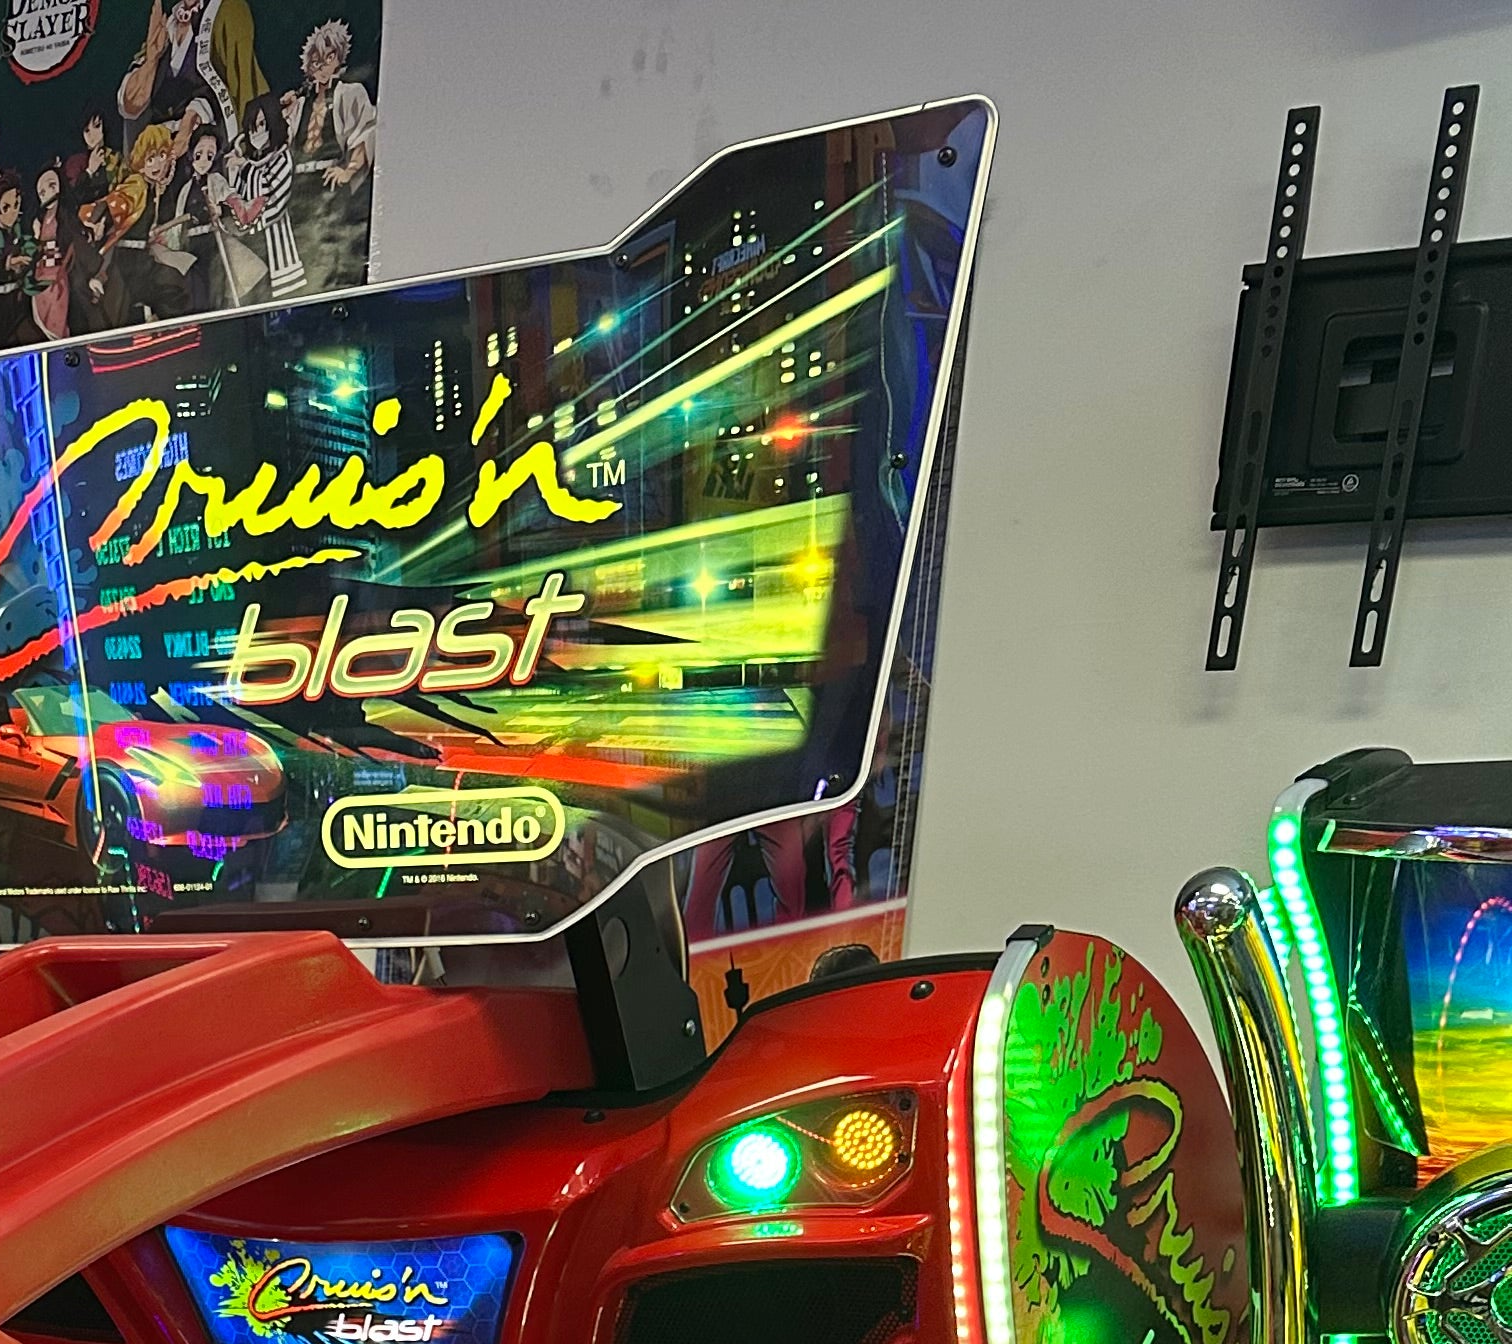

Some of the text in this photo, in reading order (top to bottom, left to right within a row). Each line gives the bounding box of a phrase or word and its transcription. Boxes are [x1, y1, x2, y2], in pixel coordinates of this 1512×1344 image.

[0, 3, 93, 58] SLAYER
[589, 462, 625, 486] TM
[221, 573, 585, 705] blast
[248, 1258, 448, 1324] Cruis'n
[331, 1313, 442, 1342] blast
